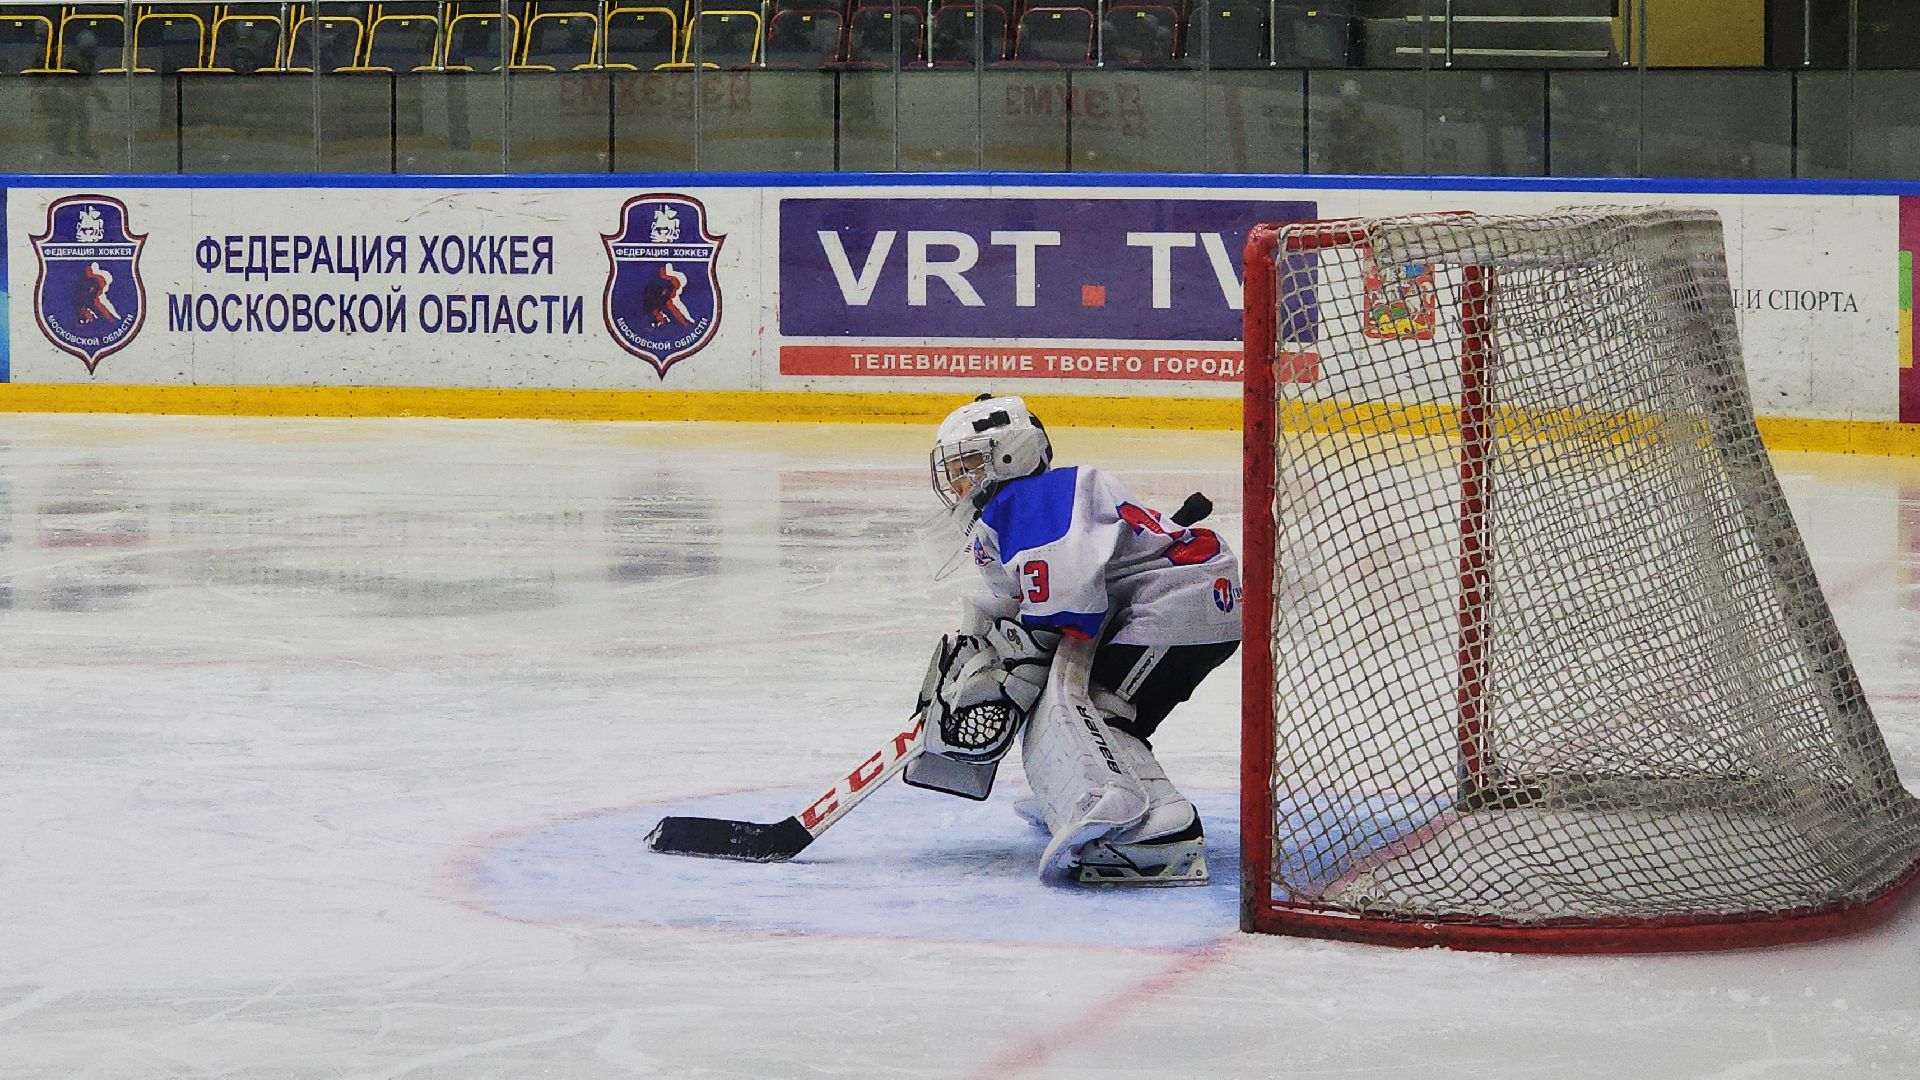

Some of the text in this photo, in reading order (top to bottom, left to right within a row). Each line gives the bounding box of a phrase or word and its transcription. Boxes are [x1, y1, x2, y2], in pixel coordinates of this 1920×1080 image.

[44, 247, 132, 257] ФЕДЕРАЦИЯ ХОККЕЯ
[195, 235, 553, 281] ФЕДЕРАЦИЯ ХОККЕЯ
[615, 248, 709, 258] ФЕДЕРАЦИЯ ХОККЕЯ
[816, 229, 1062, 308] VRT
[168, 285, 583, 334] МОСКОВСКОЙ ОБЛАСТИ
[1746, 289, 1763, 310] И
[1768, 289, 1859, 313] СПОРТА
[47, 313, 134, 346] МОСКОВСКОЙ ОБЛАСТИ
[616, 317, 708, 351] МОСКОВСКОЙ ОБЛАСТИ
[850, 353, 1034, 374] ТЕЛЕВИДЕНИЕ
[1043, 355, 1143, 374] ТВОЕГО
[1076, 704, 1122, 775] BAUER
